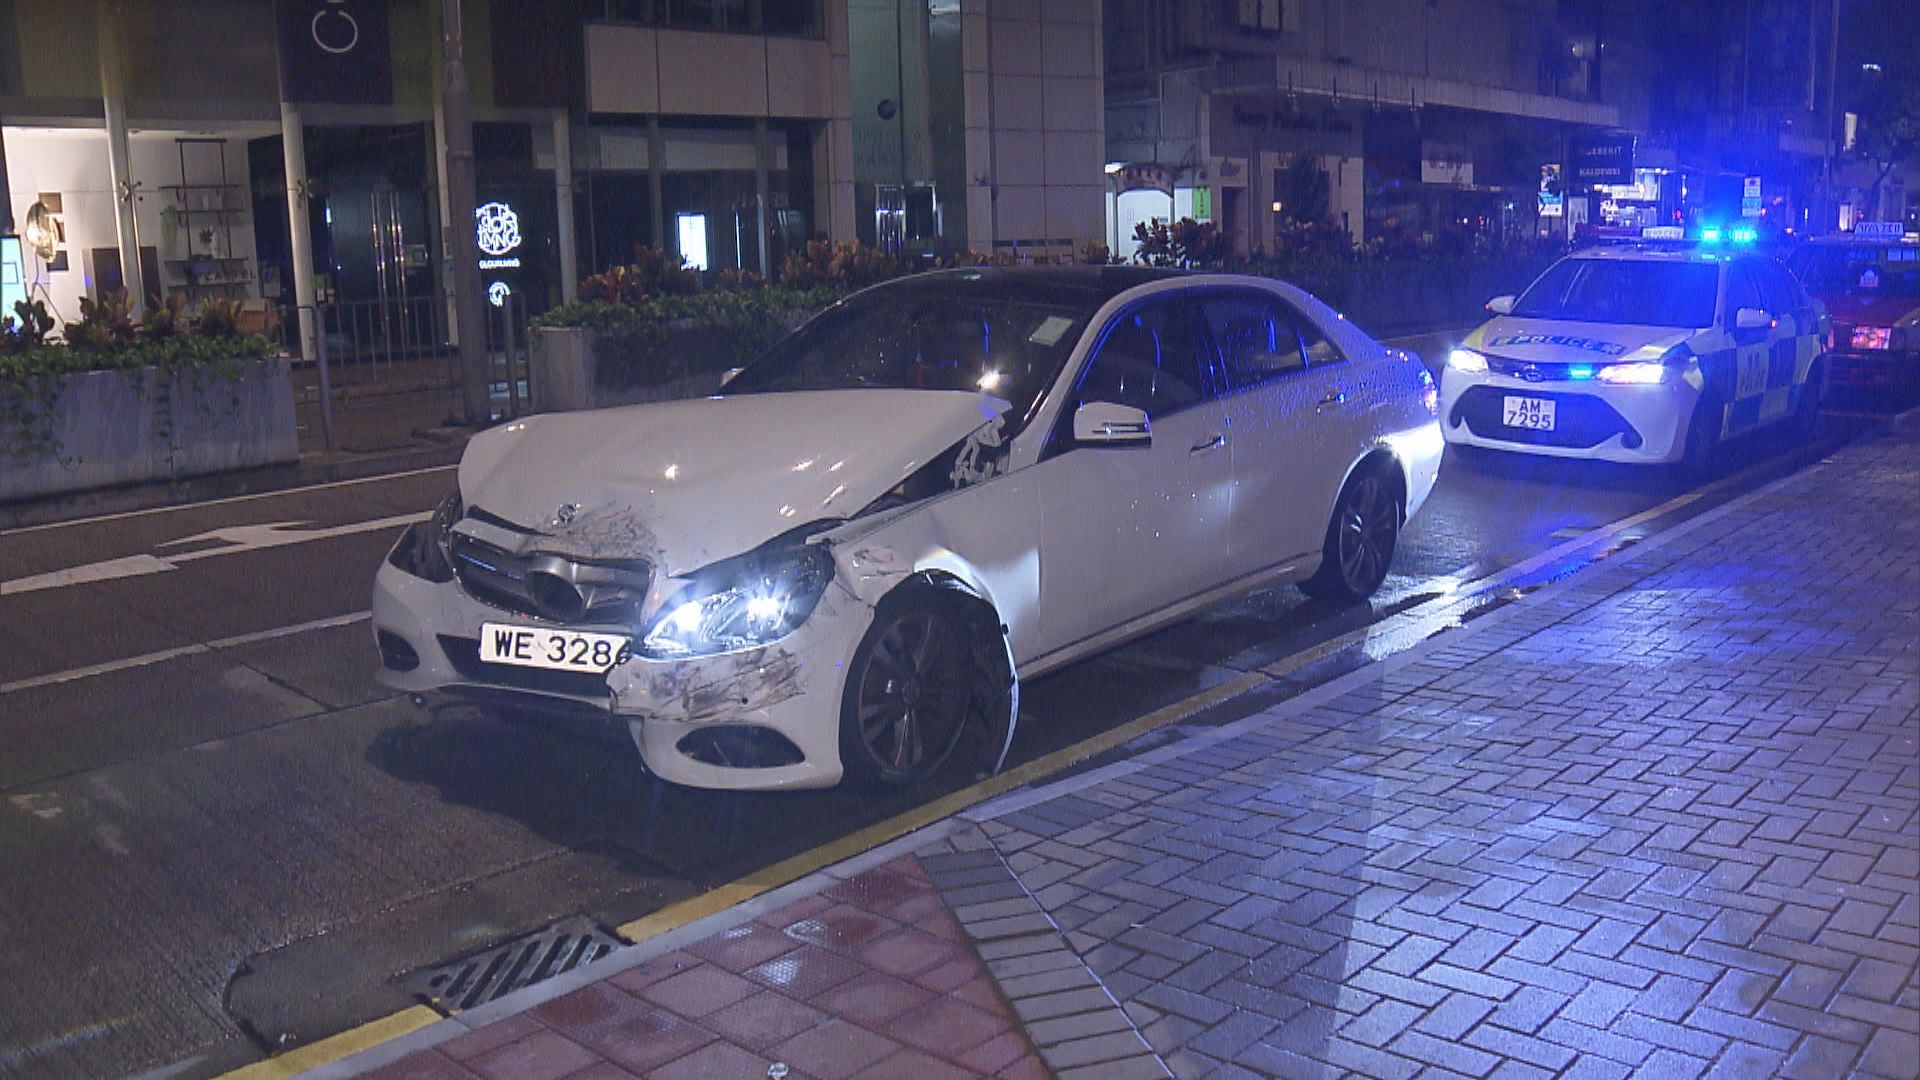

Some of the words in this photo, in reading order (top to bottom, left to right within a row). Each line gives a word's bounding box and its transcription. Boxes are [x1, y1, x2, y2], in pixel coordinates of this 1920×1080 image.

[1519, 399, 1541, 413] AM
[1507, 410, 1551, 429] 7295
[494, 629, 534, 659] WE
